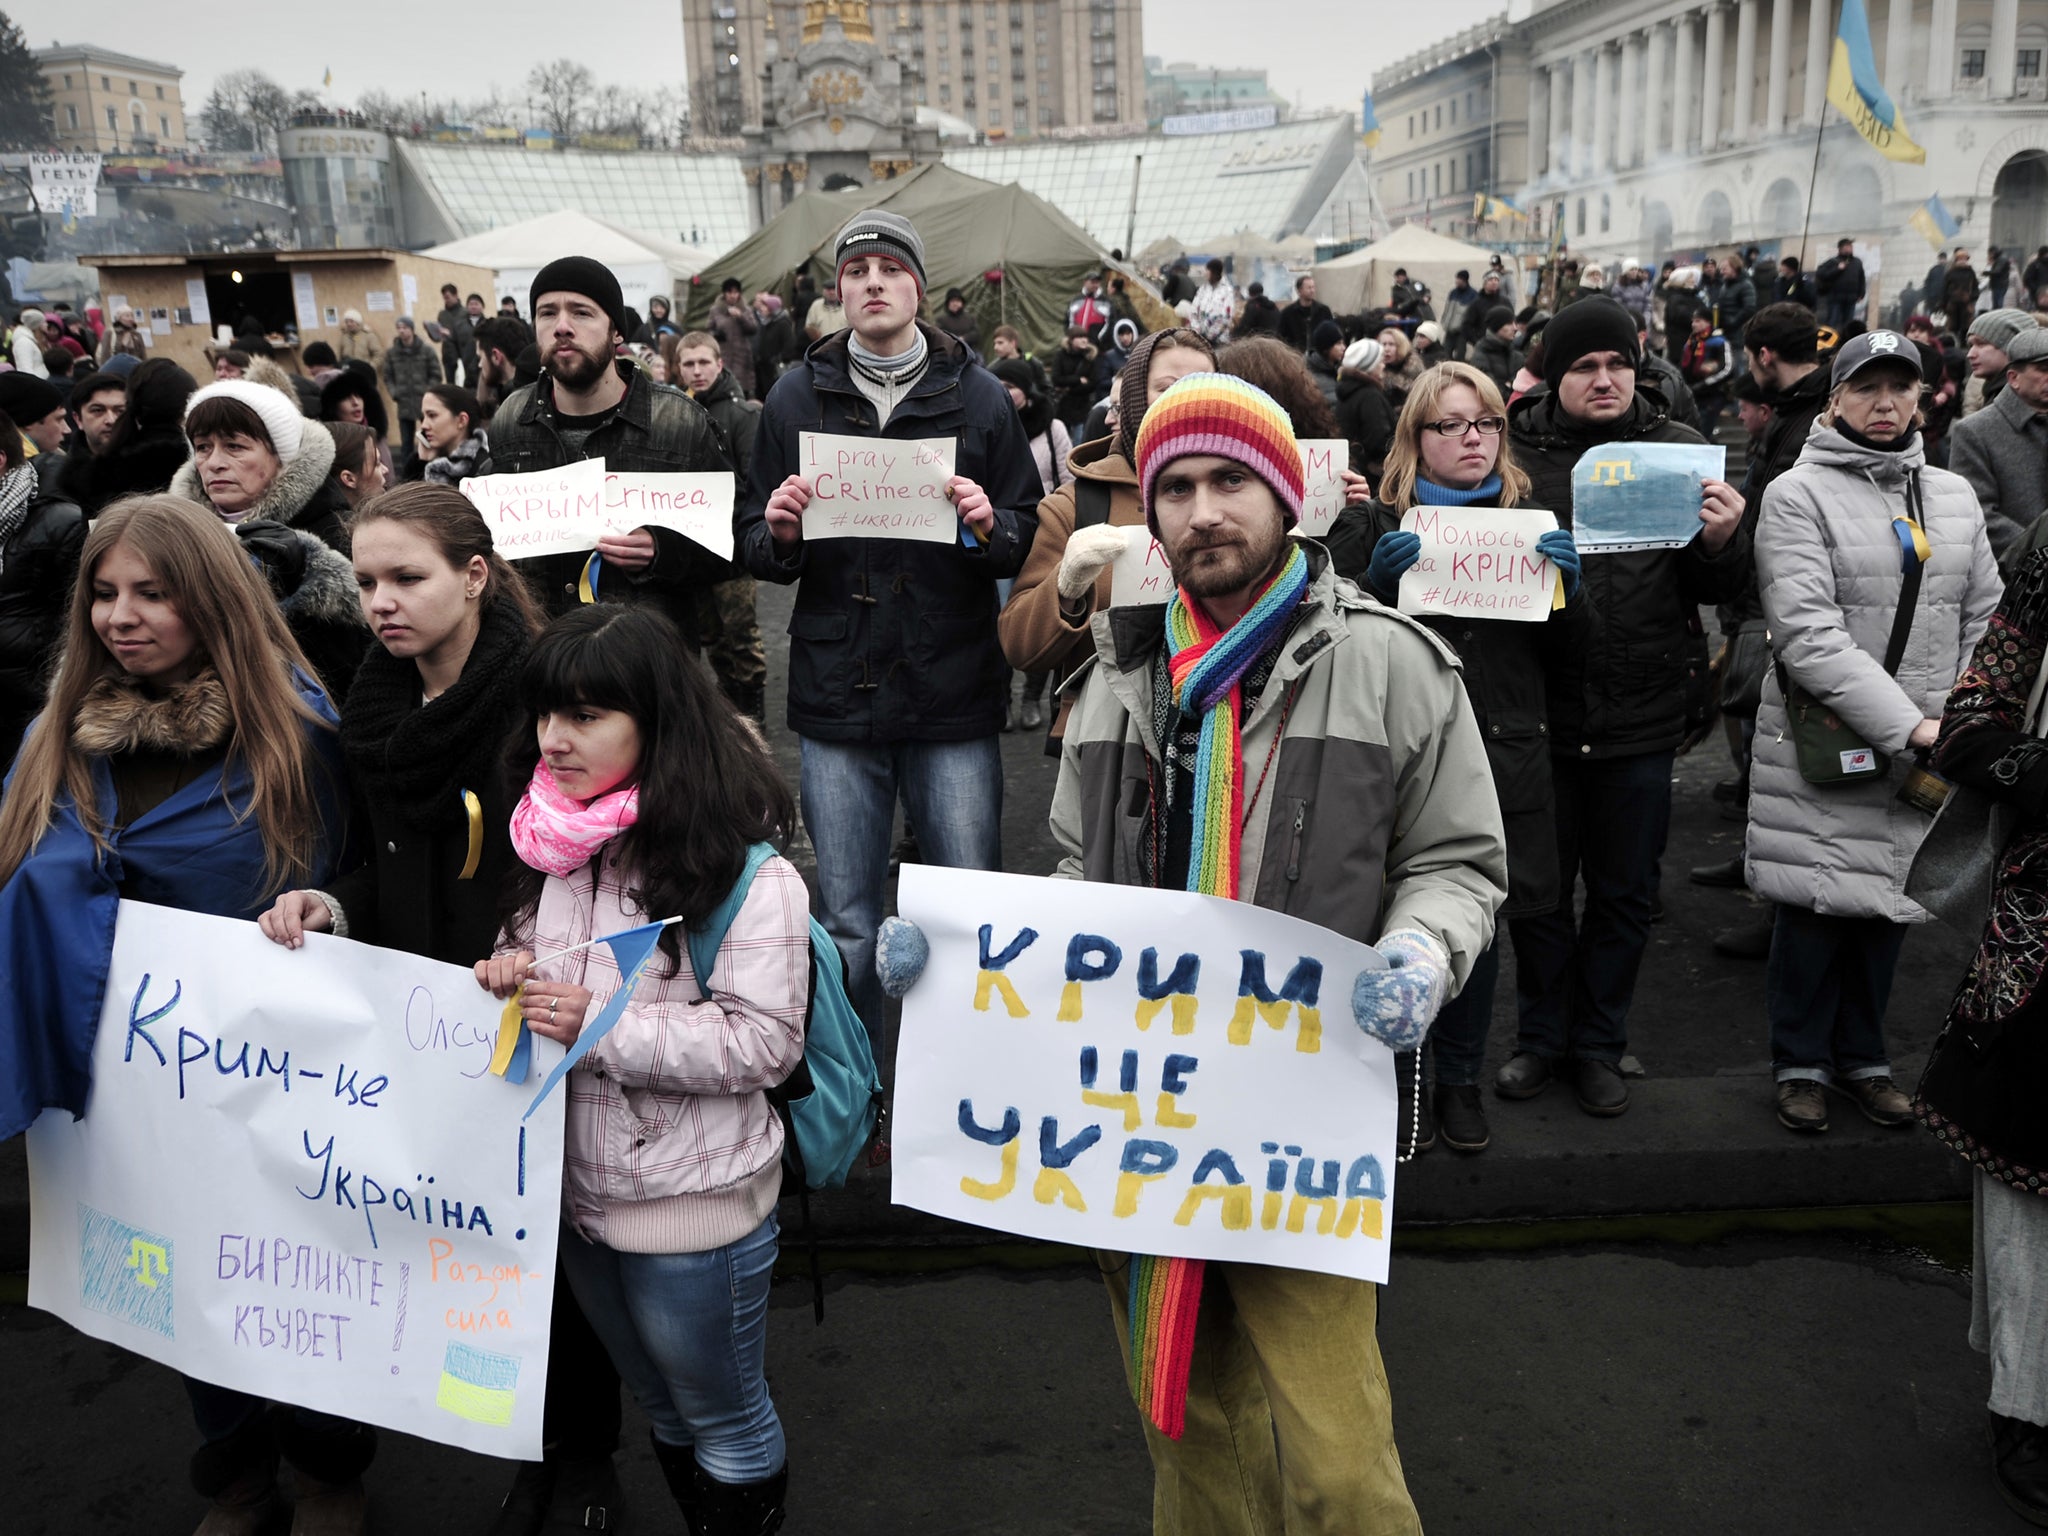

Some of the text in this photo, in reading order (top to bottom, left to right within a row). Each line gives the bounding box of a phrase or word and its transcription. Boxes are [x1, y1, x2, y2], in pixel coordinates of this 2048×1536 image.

[807, 435, 820, 466] I
[837, 449, 897, 484] pray
[499, 492, 600, 523] КРЫМ
[1452, 552, 1547, 592] КРИМ
[973, 924, 1323, 1053] КРИМ
[1080, 1045, 1199, 1131] ЦЕ
[958, 1098, 1387, 1240] УКРАЇНА
[445, 1306, 512, 1334] сила
